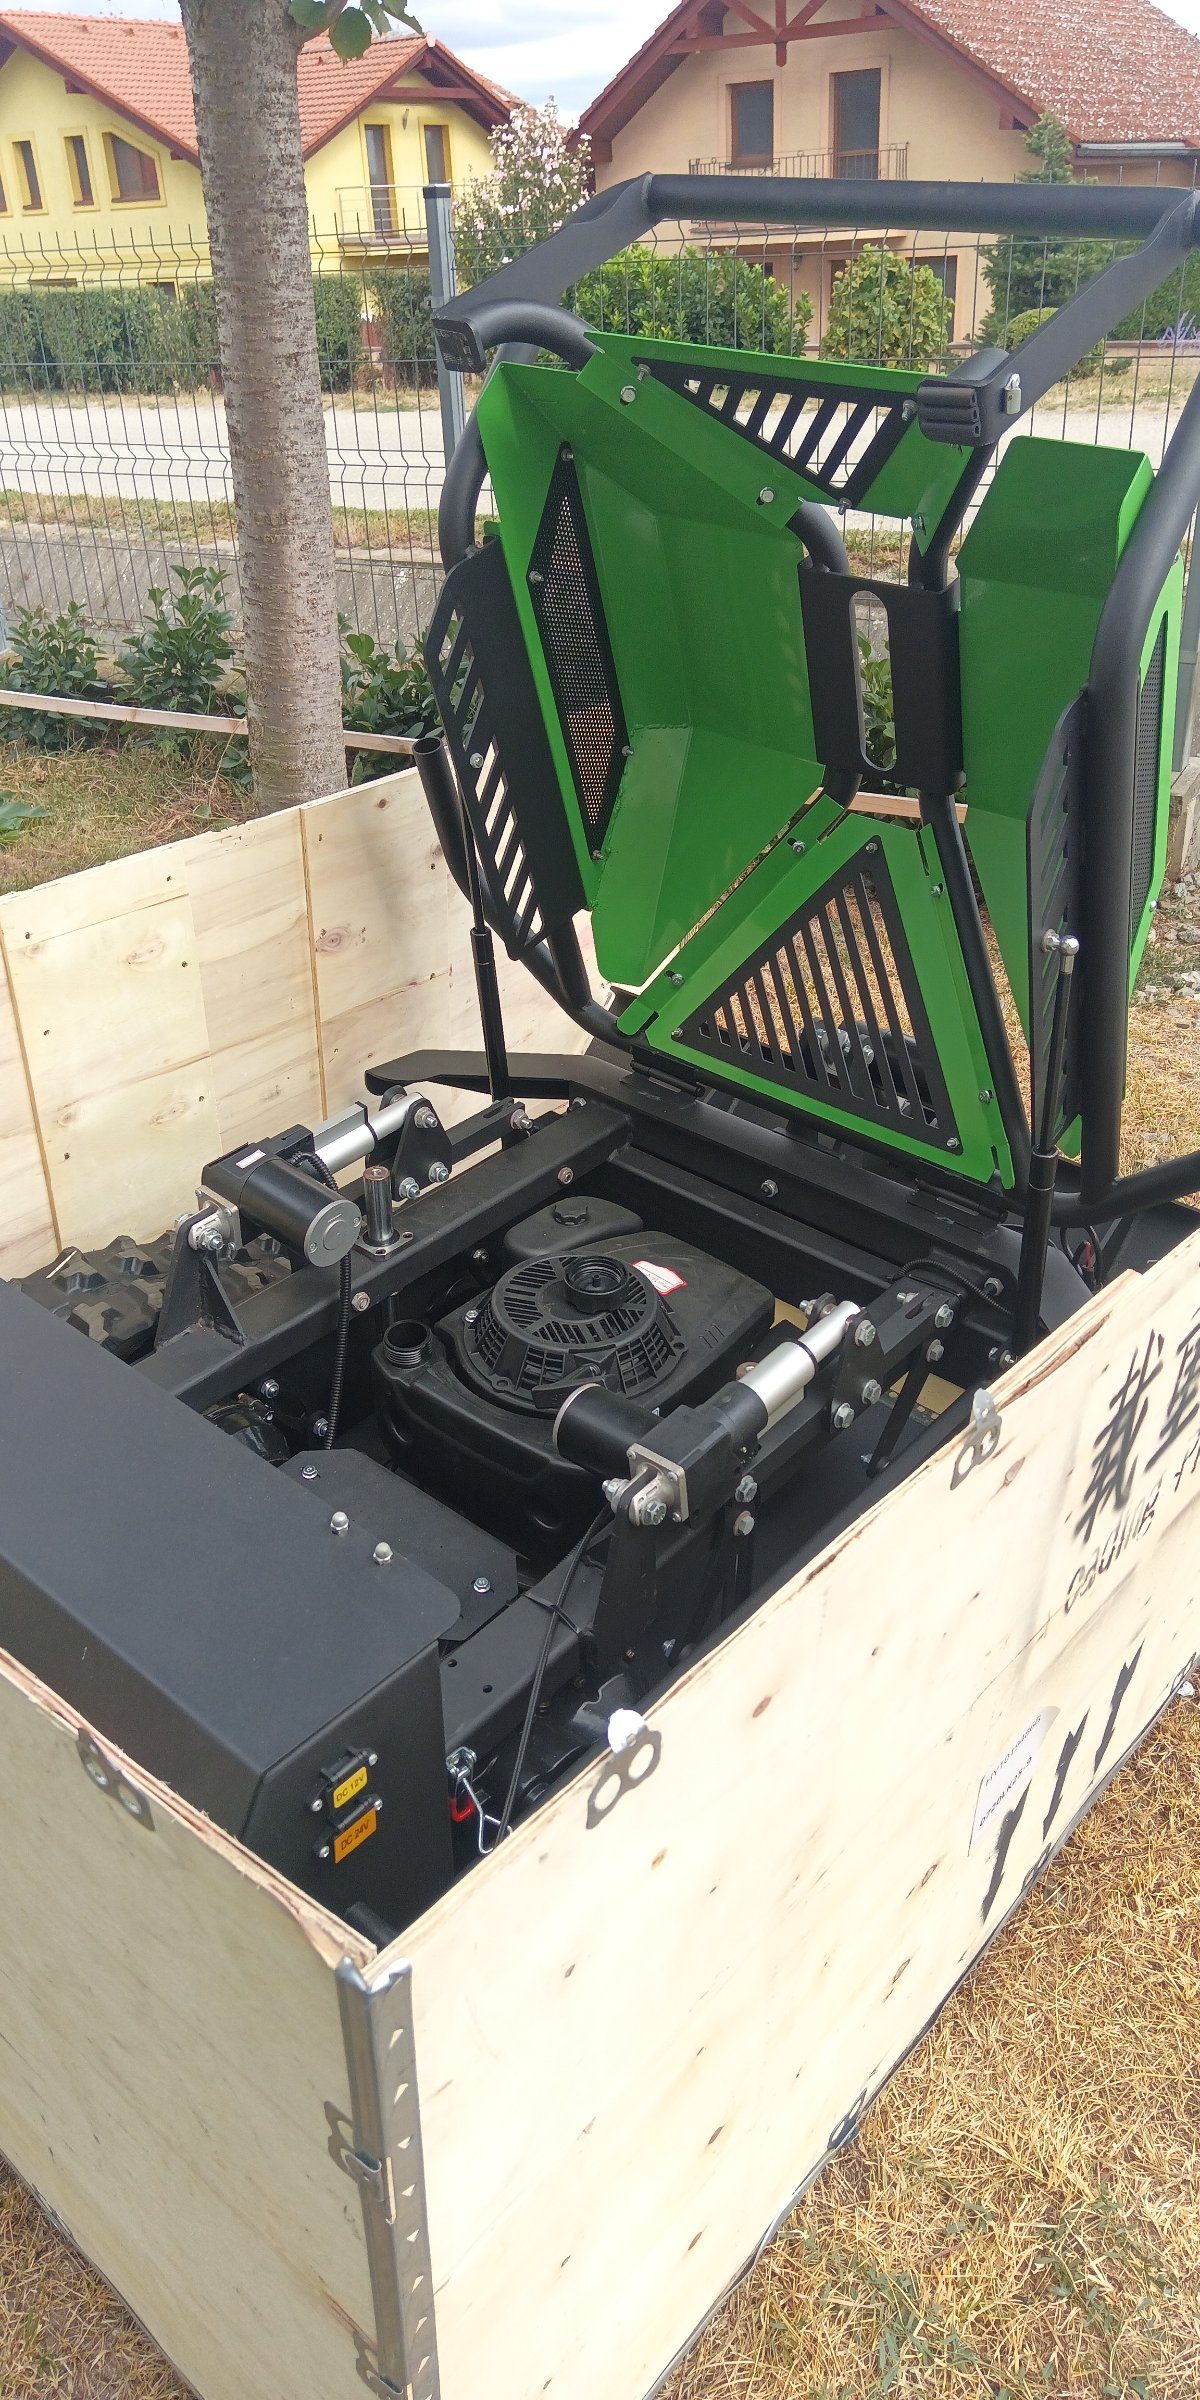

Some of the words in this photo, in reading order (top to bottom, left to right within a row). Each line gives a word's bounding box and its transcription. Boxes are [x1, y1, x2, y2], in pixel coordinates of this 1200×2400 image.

[336, 1787, 348, 1802] DC
[350, 1774, 364, 1790] 12V
[340, 1834, 353, 1851] DC
[354, 1819, 370, 1839] 24V
